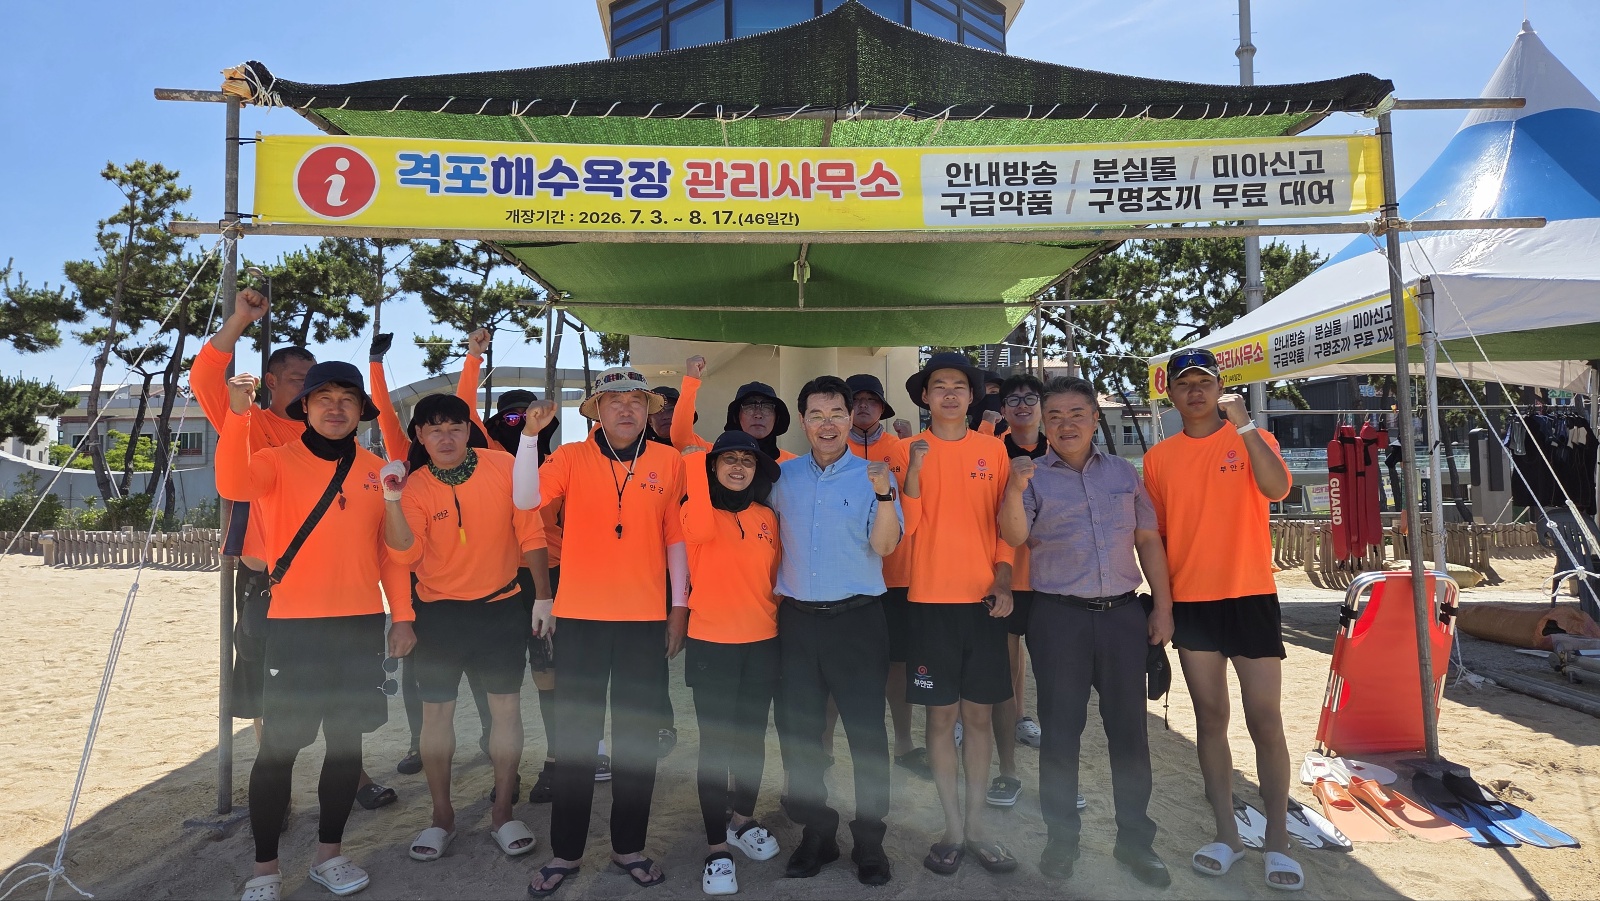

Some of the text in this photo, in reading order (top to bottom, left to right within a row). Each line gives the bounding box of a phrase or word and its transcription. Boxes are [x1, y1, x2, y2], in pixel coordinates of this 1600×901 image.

[396, 152, 901, 200] 격포해수욕장 관리사무소
[945, 159, 1058, 188] 안내방송
[1092, 156, 1177, 184] 분실물
[1212, 149, 1326, 179] 미아신고
[940, 189, 1053, 217] 구급약품
[1088, 182, 1202, 213] 구명조끼
[1212, 183, 1269, 209] 무료
[1279, 179, 1335, 206] 대여
[505, 209, 565, 225] 개장기간
[578, 211, 626, 224] 2026.
[1273, 348, 1305, 369] 구급약품
[1314, 336, 1351, 359] 구명조끼
[1353, 330, 1375, 349] 무료
[1274, 330, 1305, 352] 안내방송
[1315, 319, 1342, 341] 분실물
[1216, 342, 1264, 371] 관리사무소
[641, 482, 664, 495] 부안군
[970, 471, 993, 481] 부안군
[1330, 477, 1343, 526] GUARD
[913, 678, 934, 689] 부안군
